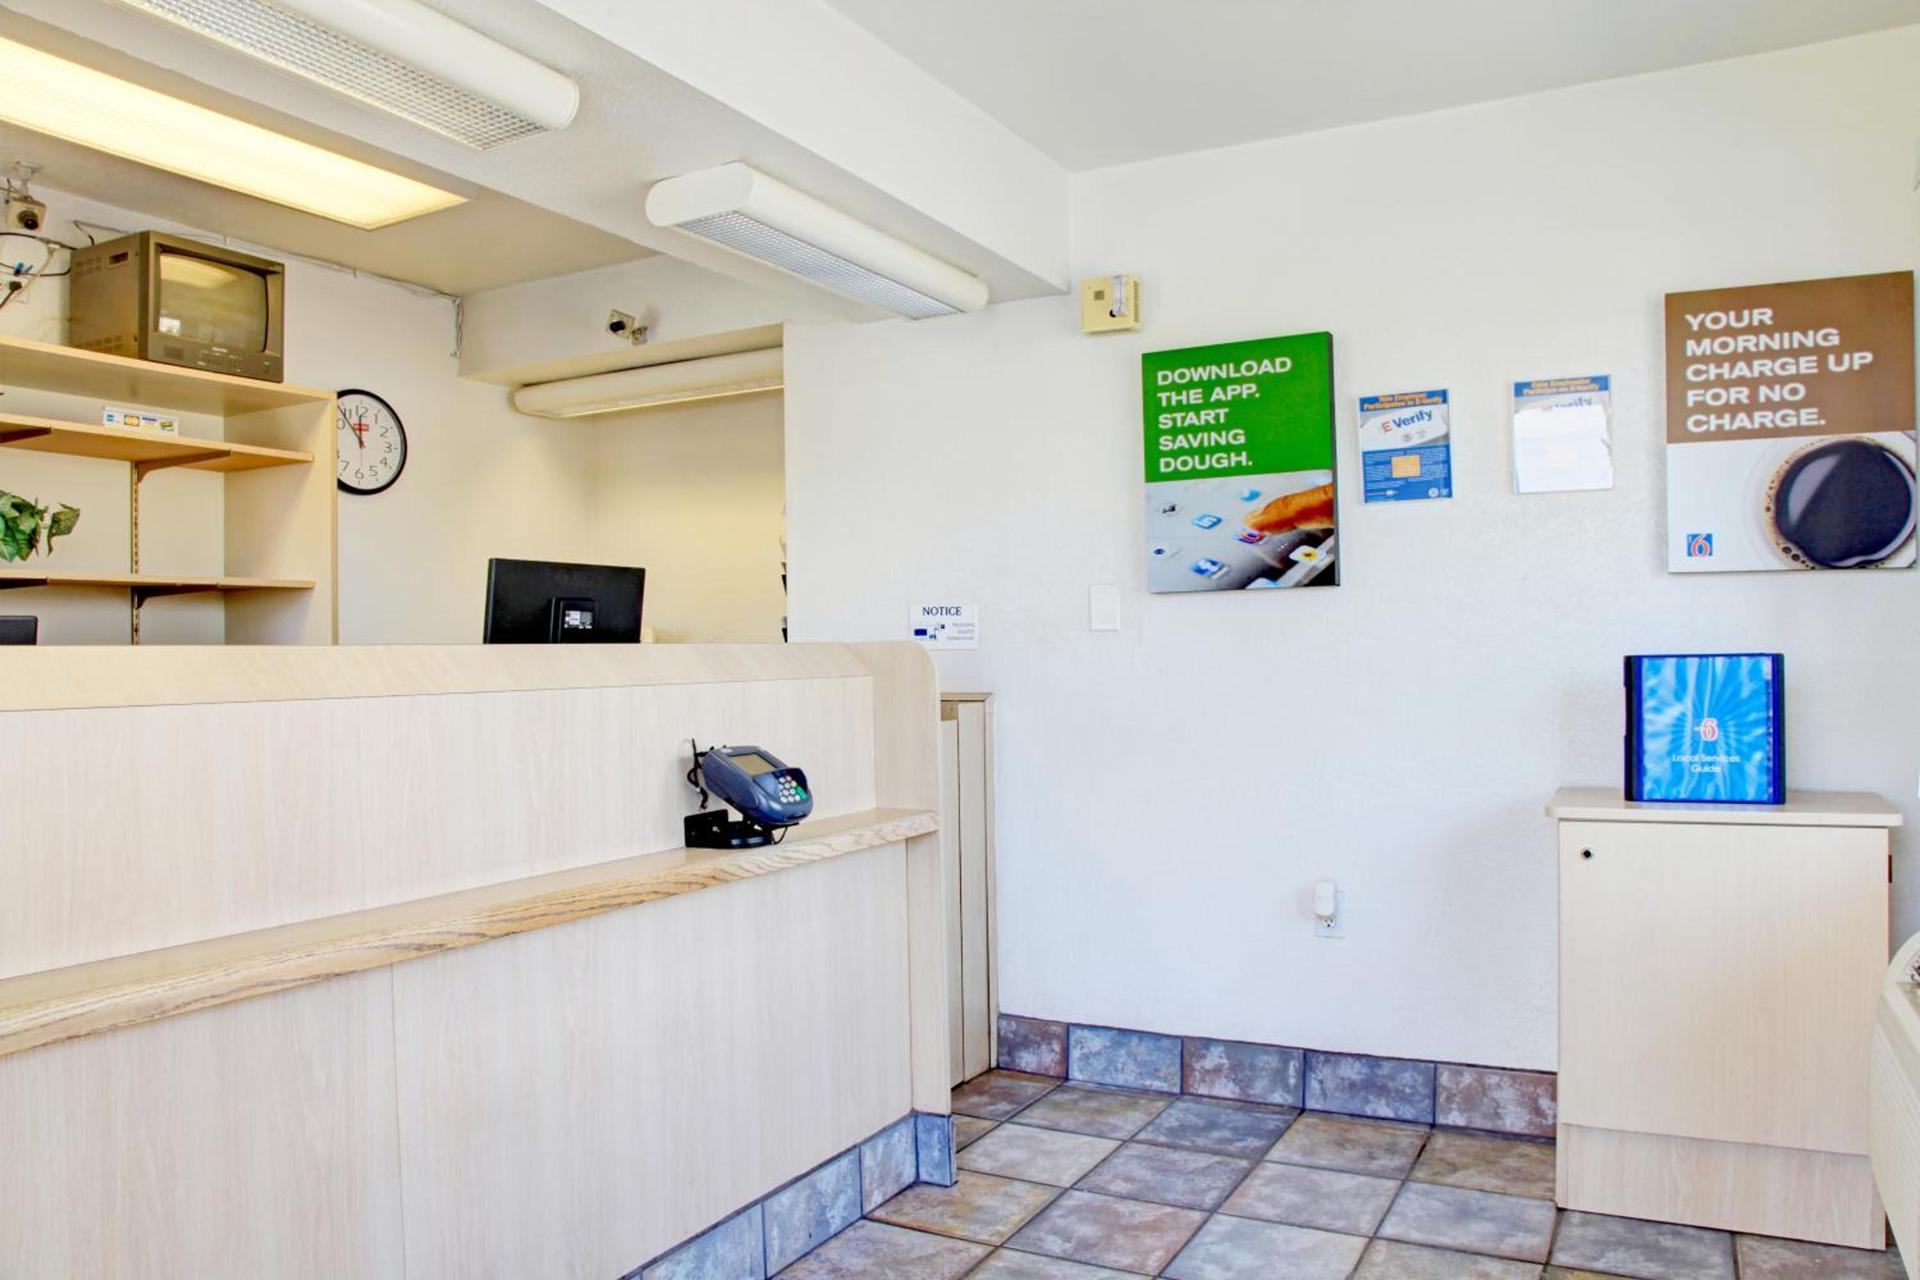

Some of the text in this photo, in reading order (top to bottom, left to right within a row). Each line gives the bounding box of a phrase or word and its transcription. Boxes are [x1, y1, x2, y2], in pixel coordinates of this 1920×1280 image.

[1684, 308, 1774, 332] YOUR
[1686, 328, 1840, 356] MORNING
[1157, 357, 1292, 386] DOWNLOAD
[1686, 351, 1873, 382] CHARGE UP
[1157, 383, 1260, 407] THE APP.
[1686, 383, 1806, 408] FOR NO
[355, 405, 368, 418] 12
[1158, 408, 1229, 429] START
[1686, 408, 1826, 433] CHARGE.
[380, 427, 388, 438] 2
[1158, 429, 1246, 451] SAVING
[385, 443, 393, 453] 3
[341, 460, 350, 472] 7
[369, 465, 378, 477] 5
[380, 457, 387, 468] 4
[1159, 451, 1253, 473] DOUGH.
[354, 468, 364, 480] 6
[922, 606, 962, 616] NOTICE
